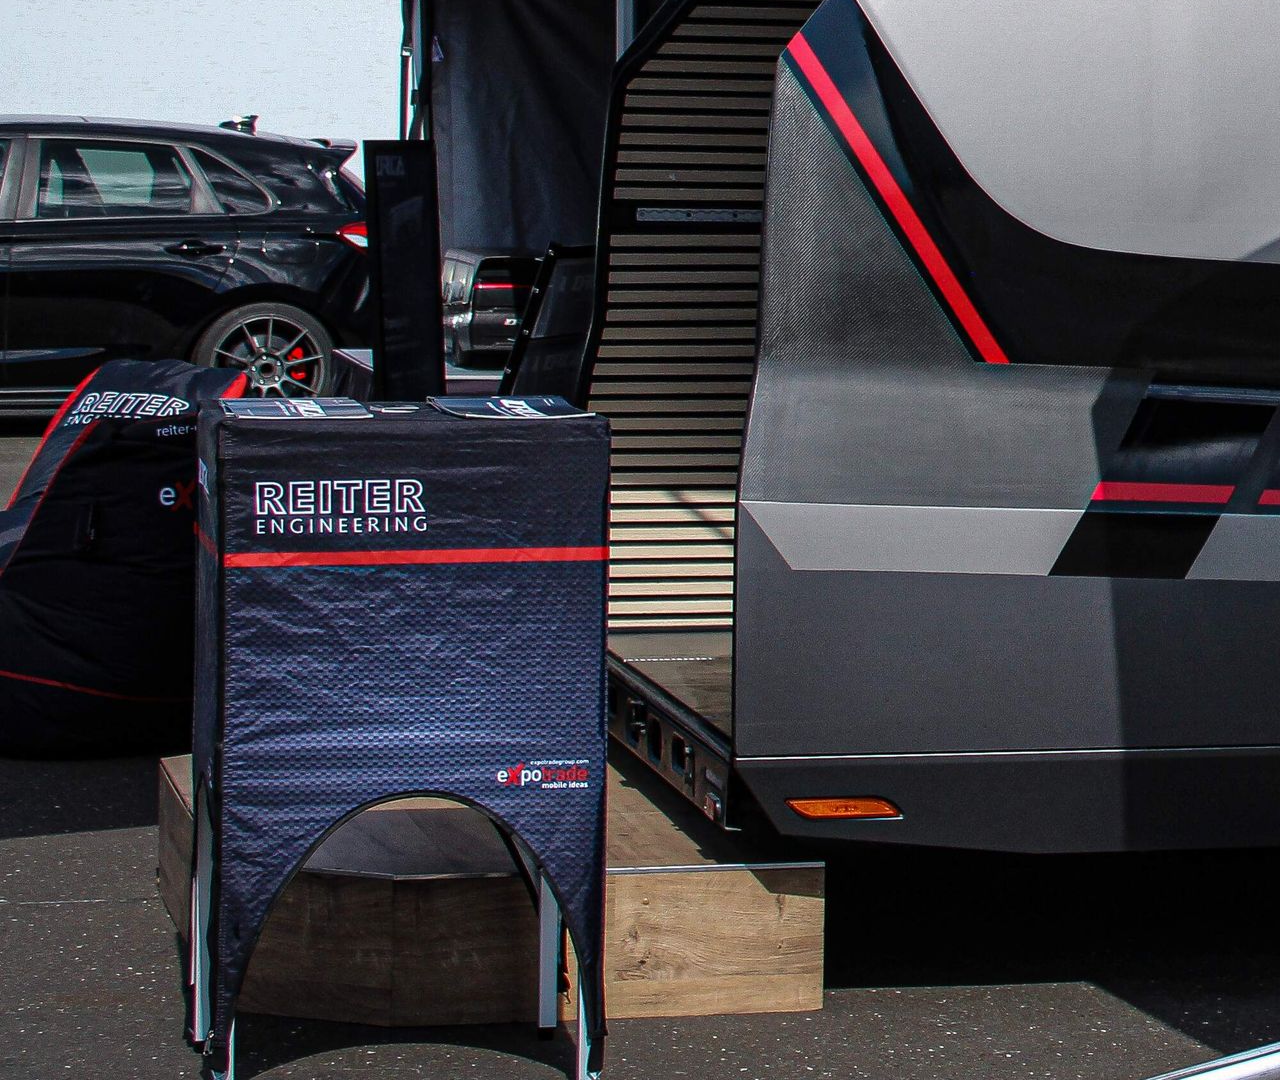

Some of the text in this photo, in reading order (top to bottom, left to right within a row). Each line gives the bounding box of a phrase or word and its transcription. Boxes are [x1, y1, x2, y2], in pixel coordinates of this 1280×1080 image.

[72, 391, 189, 418] REITER
[255, 479, 426, 515] REITER
[256, 516, 428, 535] ENGINEERING
[541, 781, 589, 789] mobile ideas
